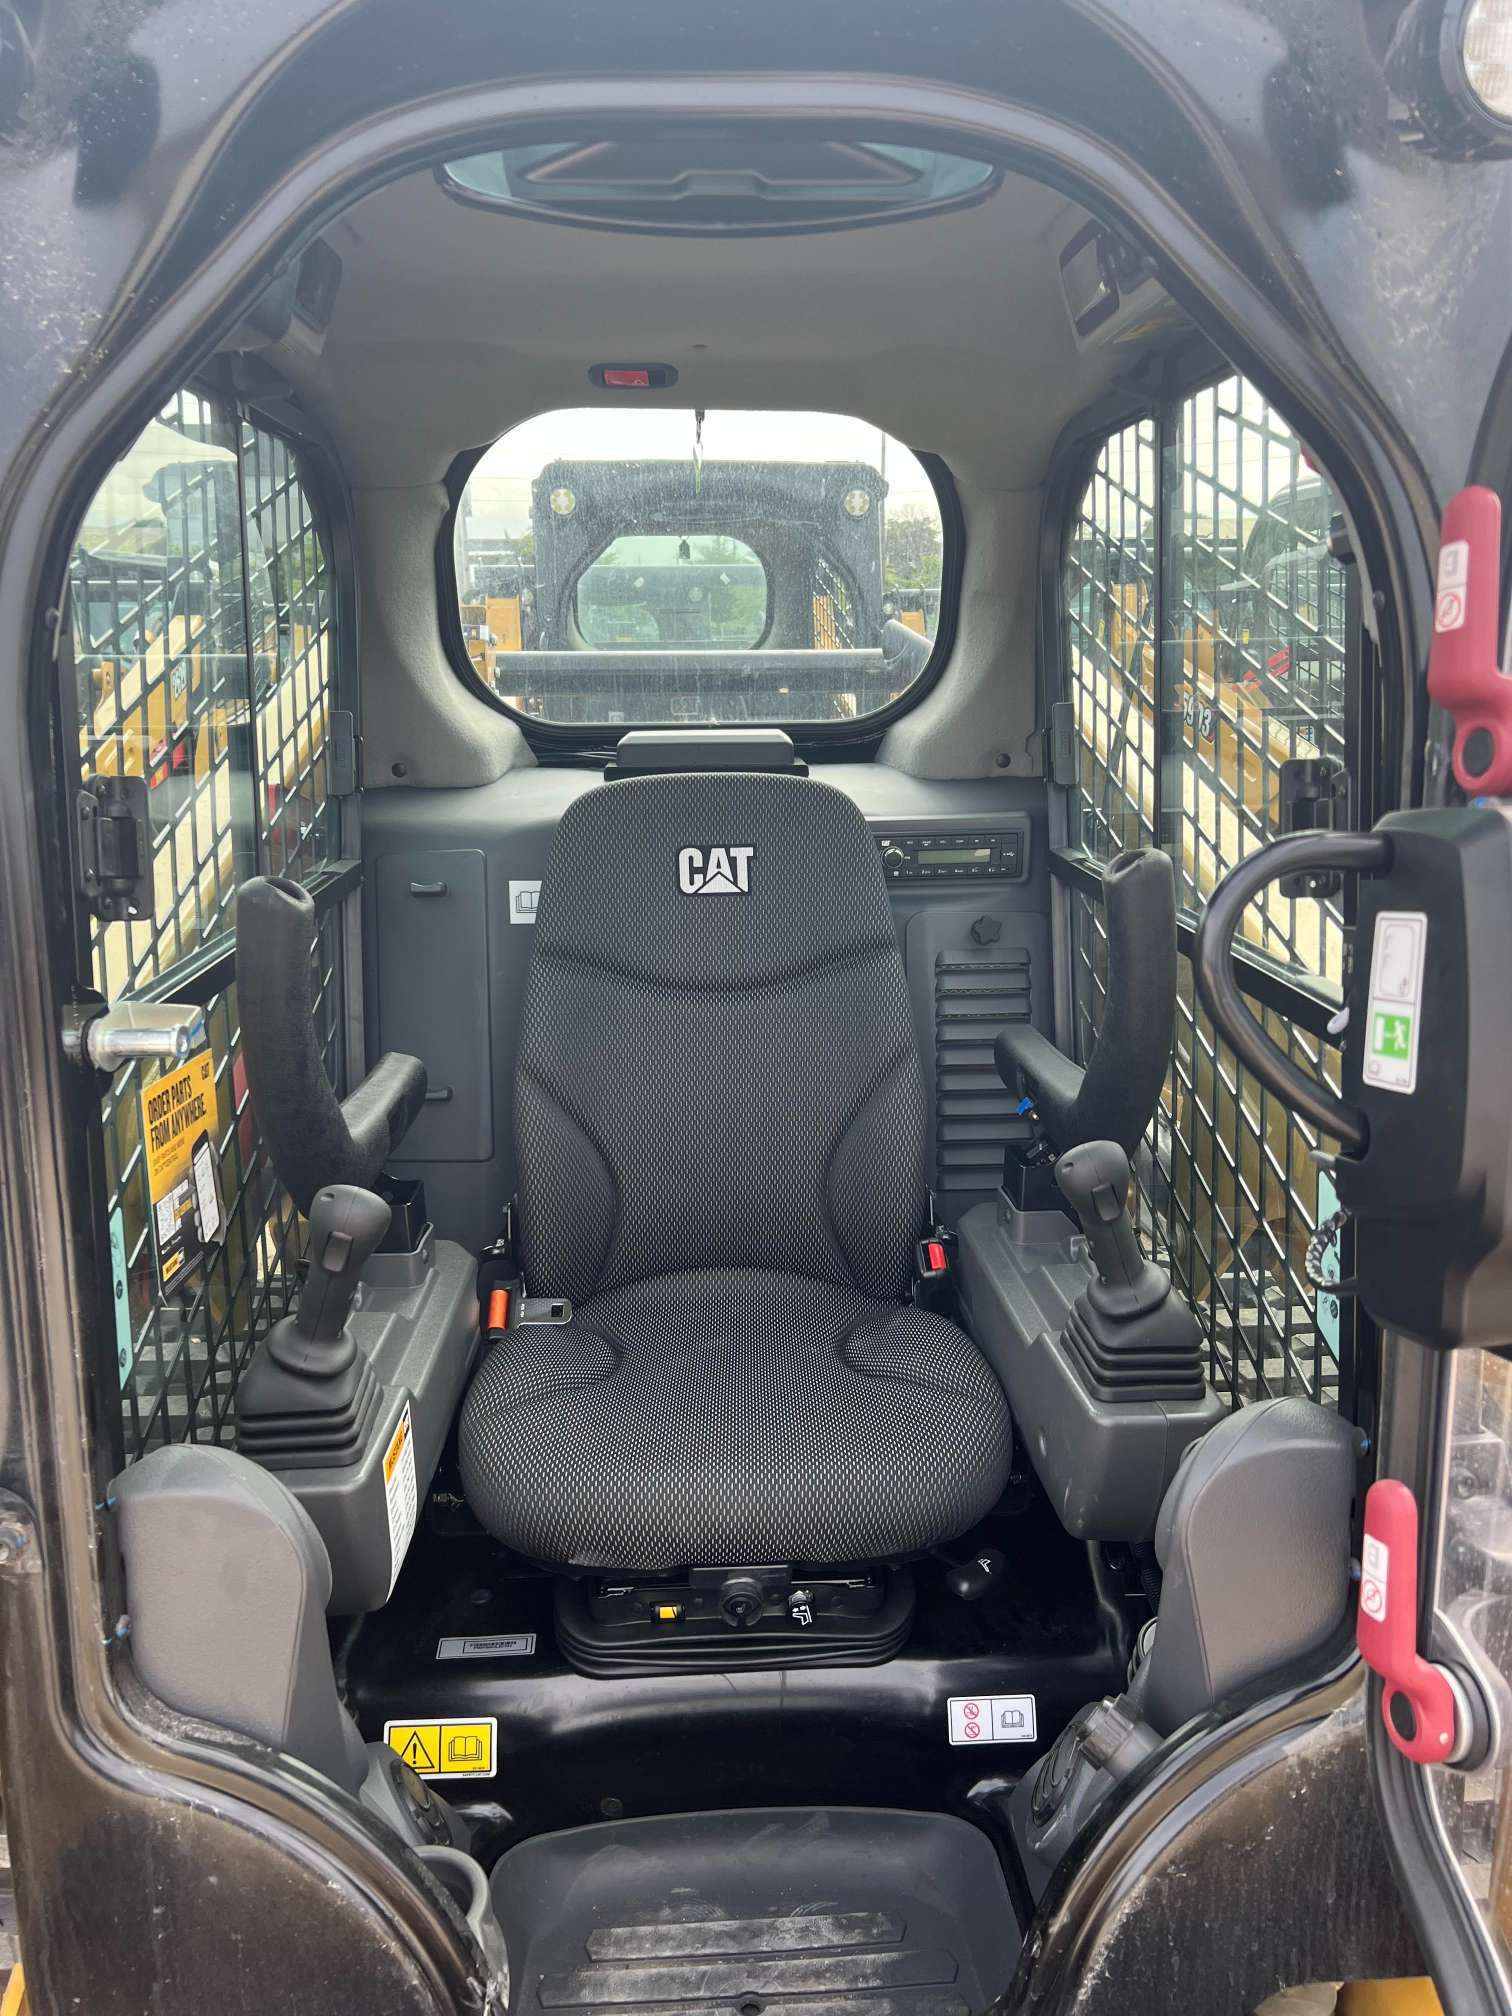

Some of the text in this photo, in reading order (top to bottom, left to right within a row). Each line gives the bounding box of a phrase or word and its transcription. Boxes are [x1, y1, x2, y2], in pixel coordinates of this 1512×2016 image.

[678, 846, 754, 894] CAT
[148, 1075, 192, 1125] ORDER PARTS
[151, 1093, 206, 1153] FROM ANYWHERE
